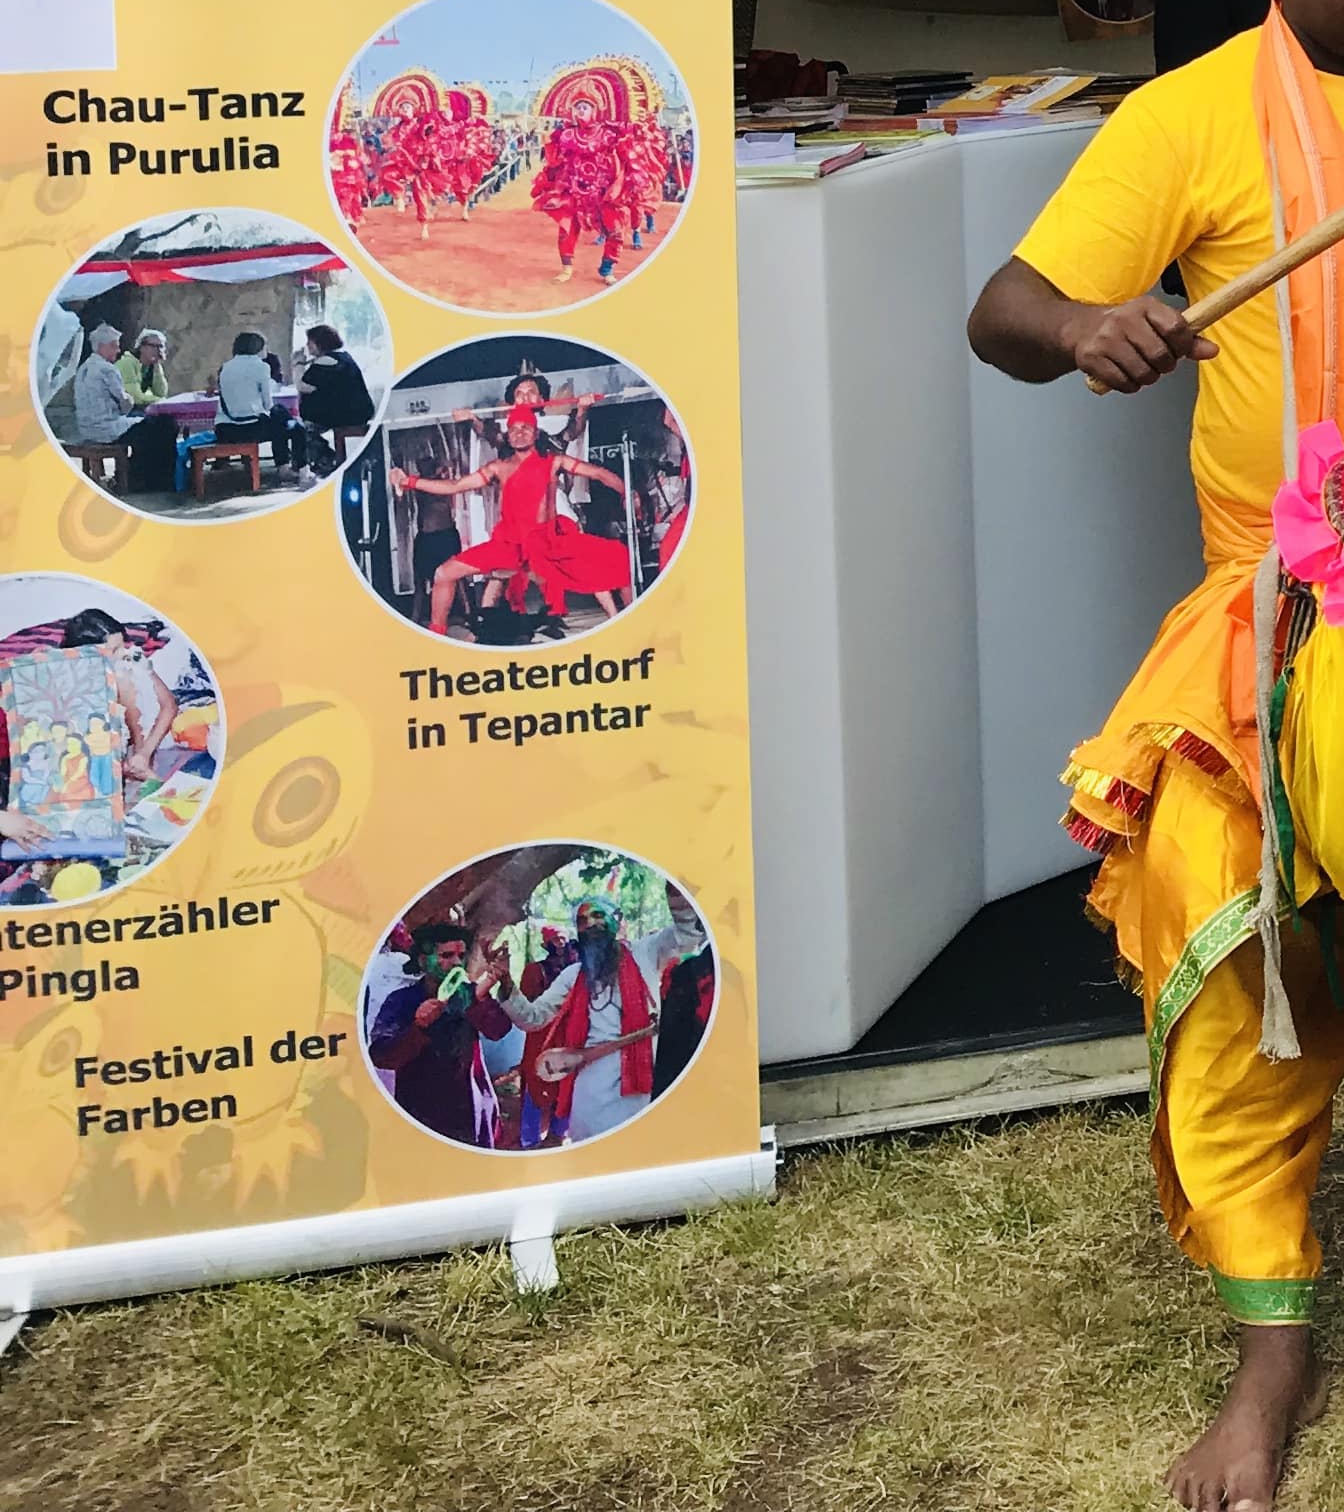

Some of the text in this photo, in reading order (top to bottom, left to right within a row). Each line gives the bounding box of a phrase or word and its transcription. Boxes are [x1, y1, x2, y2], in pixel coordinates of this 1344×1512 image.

[42, 88, 306, 125] Chau-Tanz
[46, 136, 281, 177] in Purulia
[400, 648, 655, 702] Theaterdorf
[406, 700, 652, 750] in Tepantar
[0, 896, 280, 952] tenerzähler
[0, 960, 140, 1002] Pingla
[74, 1030, 347, 1088] Festival der
[77, 1094, 238, 1137] Farben
